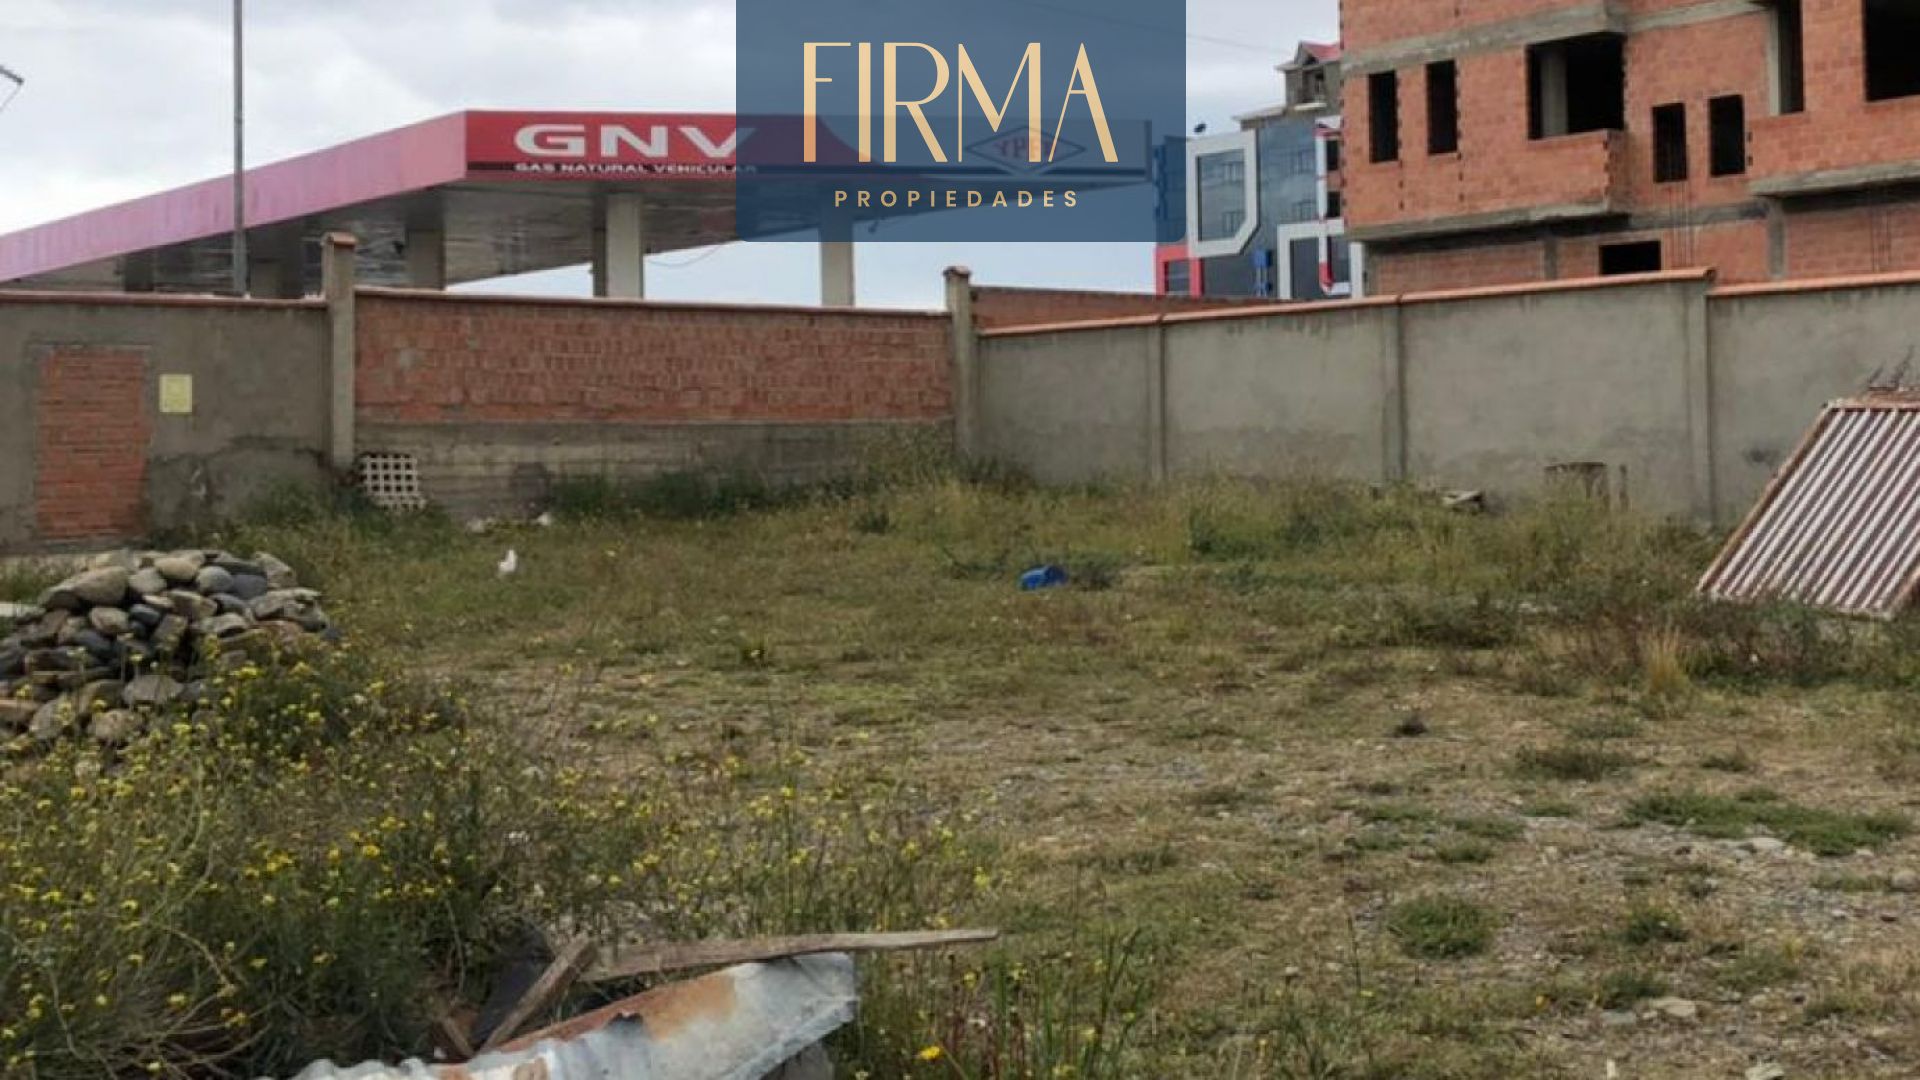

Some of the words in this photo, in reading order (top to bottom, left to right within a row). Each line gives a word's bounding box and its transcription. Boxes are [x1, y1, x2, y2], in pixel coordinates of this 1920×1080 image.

[514, 124, 757, 158] GNV
[514, 162, 556, 172] GAS
[560, 162, 649, 173] NATURAL
